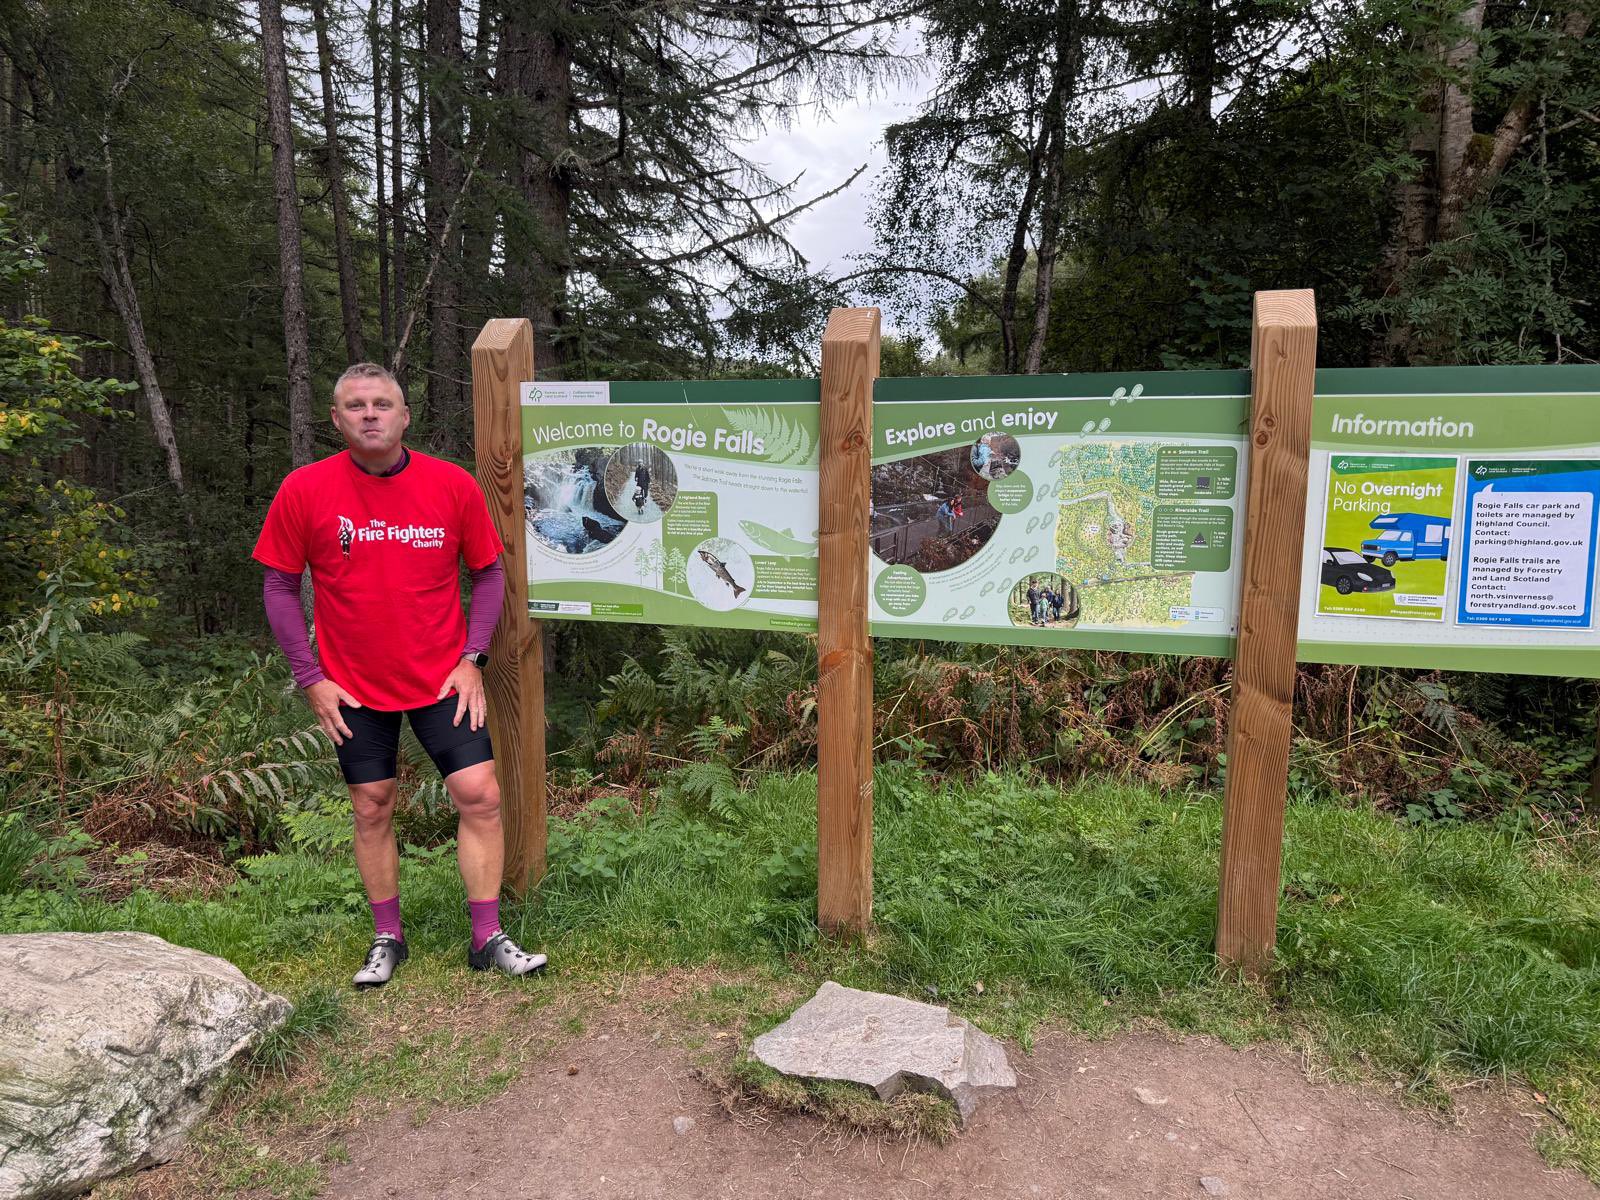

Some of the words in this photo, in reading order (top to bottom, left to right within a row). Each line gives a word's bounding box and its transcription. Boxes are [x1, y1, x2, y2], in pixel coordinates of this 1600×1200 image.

[885, 422, 956, 446] Explore
[960, 410, 996, 433] and
[1001, 407, 1058, 431] enjoy
[1331, 413, 1474, 438] Information
[532, 421, 613, 445] Welcome
[619, 420, 635, 438] to
[642, 418, 707, 450] Rogie
[713, 428, 765, 455] Falls
[1334, 481, 1356, 495] No
[1361, 481, 1443, 500] Overnight
[1333, 497, 1391, 515] Parking
[1477, 502, 1501, 510] Rogie
[1541, 502, 1562, 510] park
[369, 519, 386, 528] The
[1475, 520, 1514, 528] Highland
[1516, 520, 1550, 528] Council.
[357, 527, 385, 542] Fire
[387, 524, 445, 543] Fighters
[412, 539, 443, 549] Charity
[1474, 538, 1583, 546] parking@highland.gov.uk
[1473, 556, 1497, 564] Rogie
[1472, 566, 1511, 574] managed
[1526, 567, 1563, 575] Forestry
[1470, 592, 1554, 601] north.vsinverness@
[1470, 601, 1577, 611] forestryandland.gov.scot
